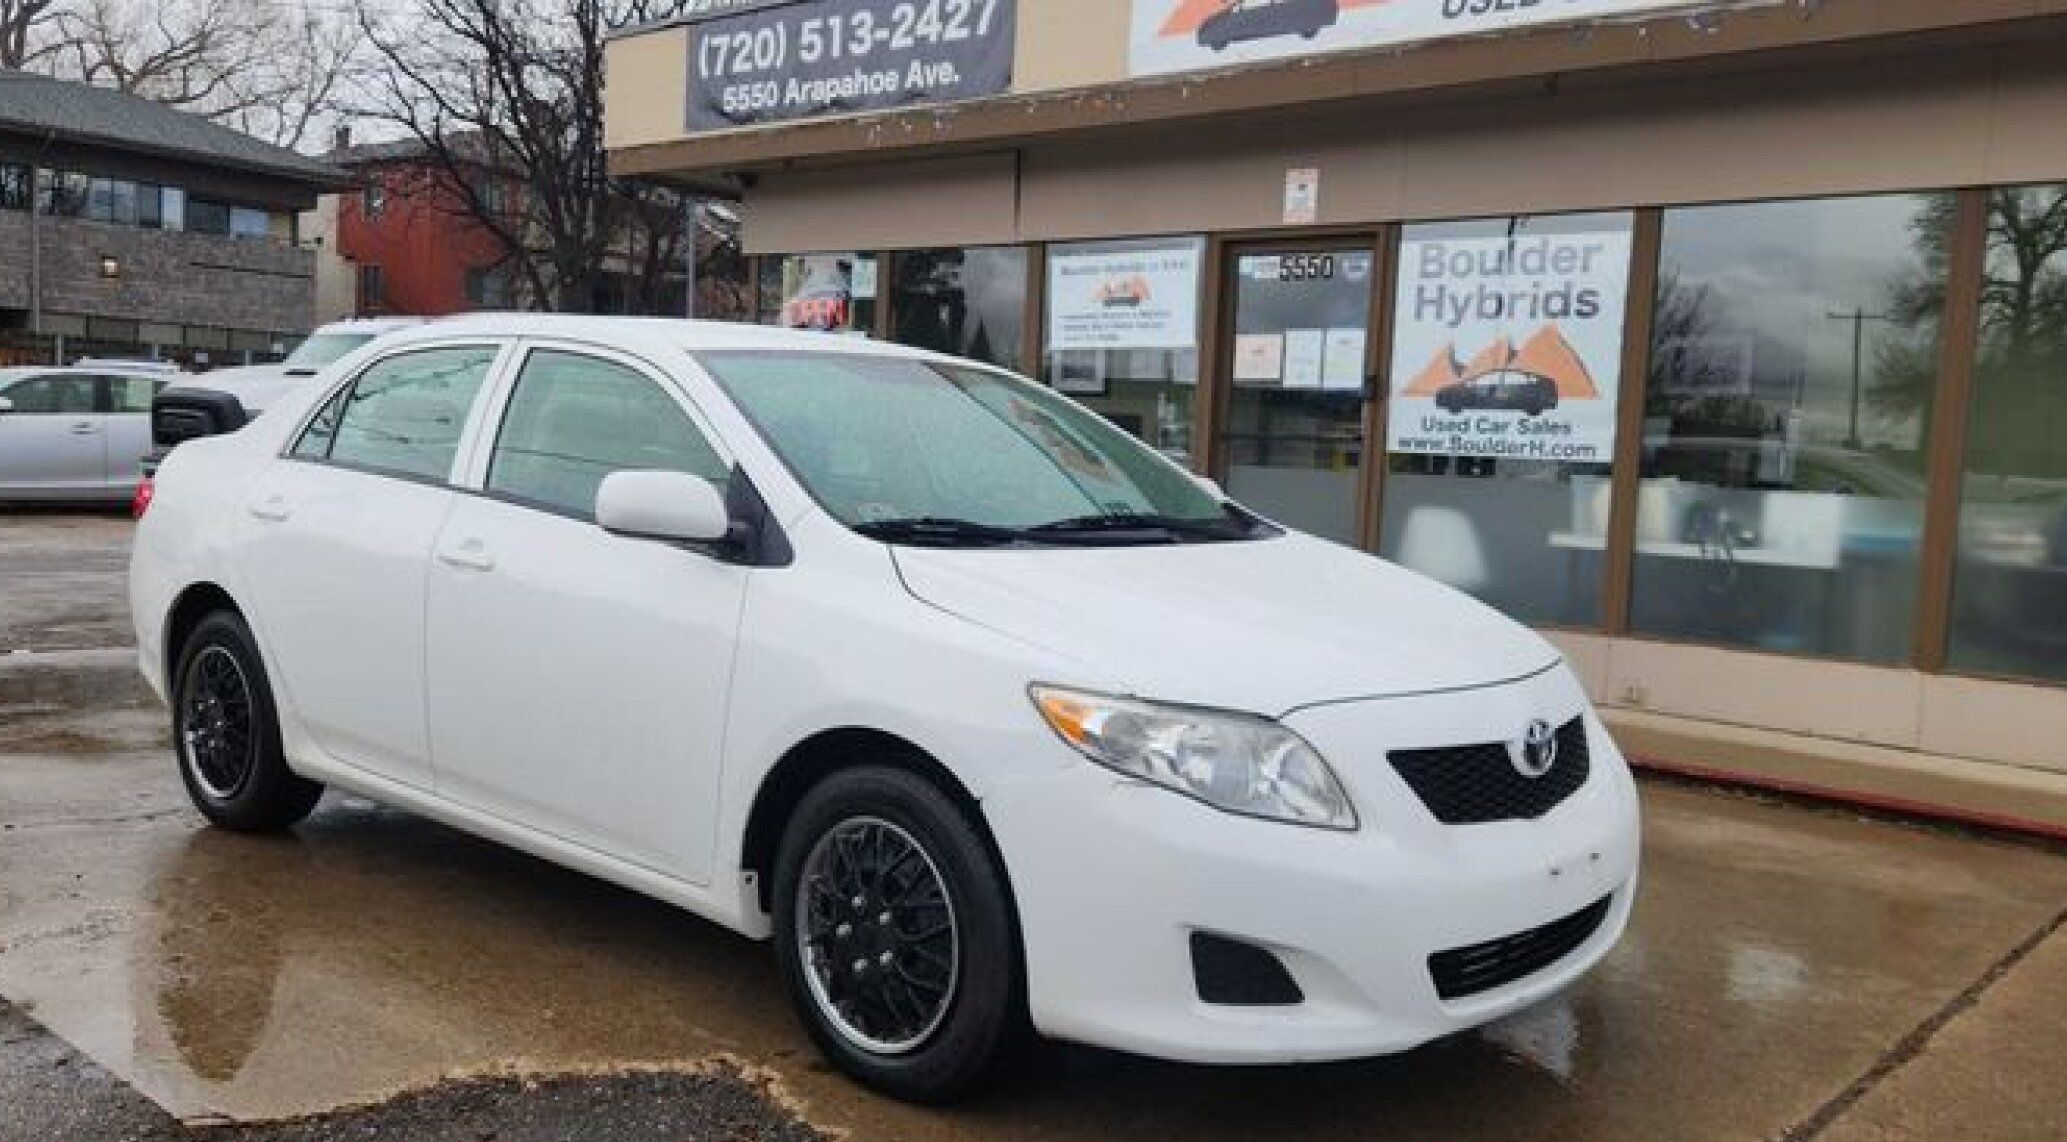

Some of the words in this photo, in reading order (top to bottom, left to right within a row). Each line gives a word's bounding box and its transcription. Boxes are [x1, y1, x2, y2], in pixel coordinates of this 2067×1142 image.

[699, 21, 785, 79] (720)
[800, 0, 993, 63] 513-2427
[723, 81, 775, 113] 5550
[784, 69, 899, 105] Arapahoe
[906, 59, 959, 88] Ave.
[1280, 255, 1334, 282] 5550
[1418, 238, 1602, 279] Boulder
[1414, 281, 1601, 328] Hybrids
[1421, 417, 1470, 433] Used
[1476, 418, 1510, 434] Car
[1517, 417, 1571, 435] Sales
